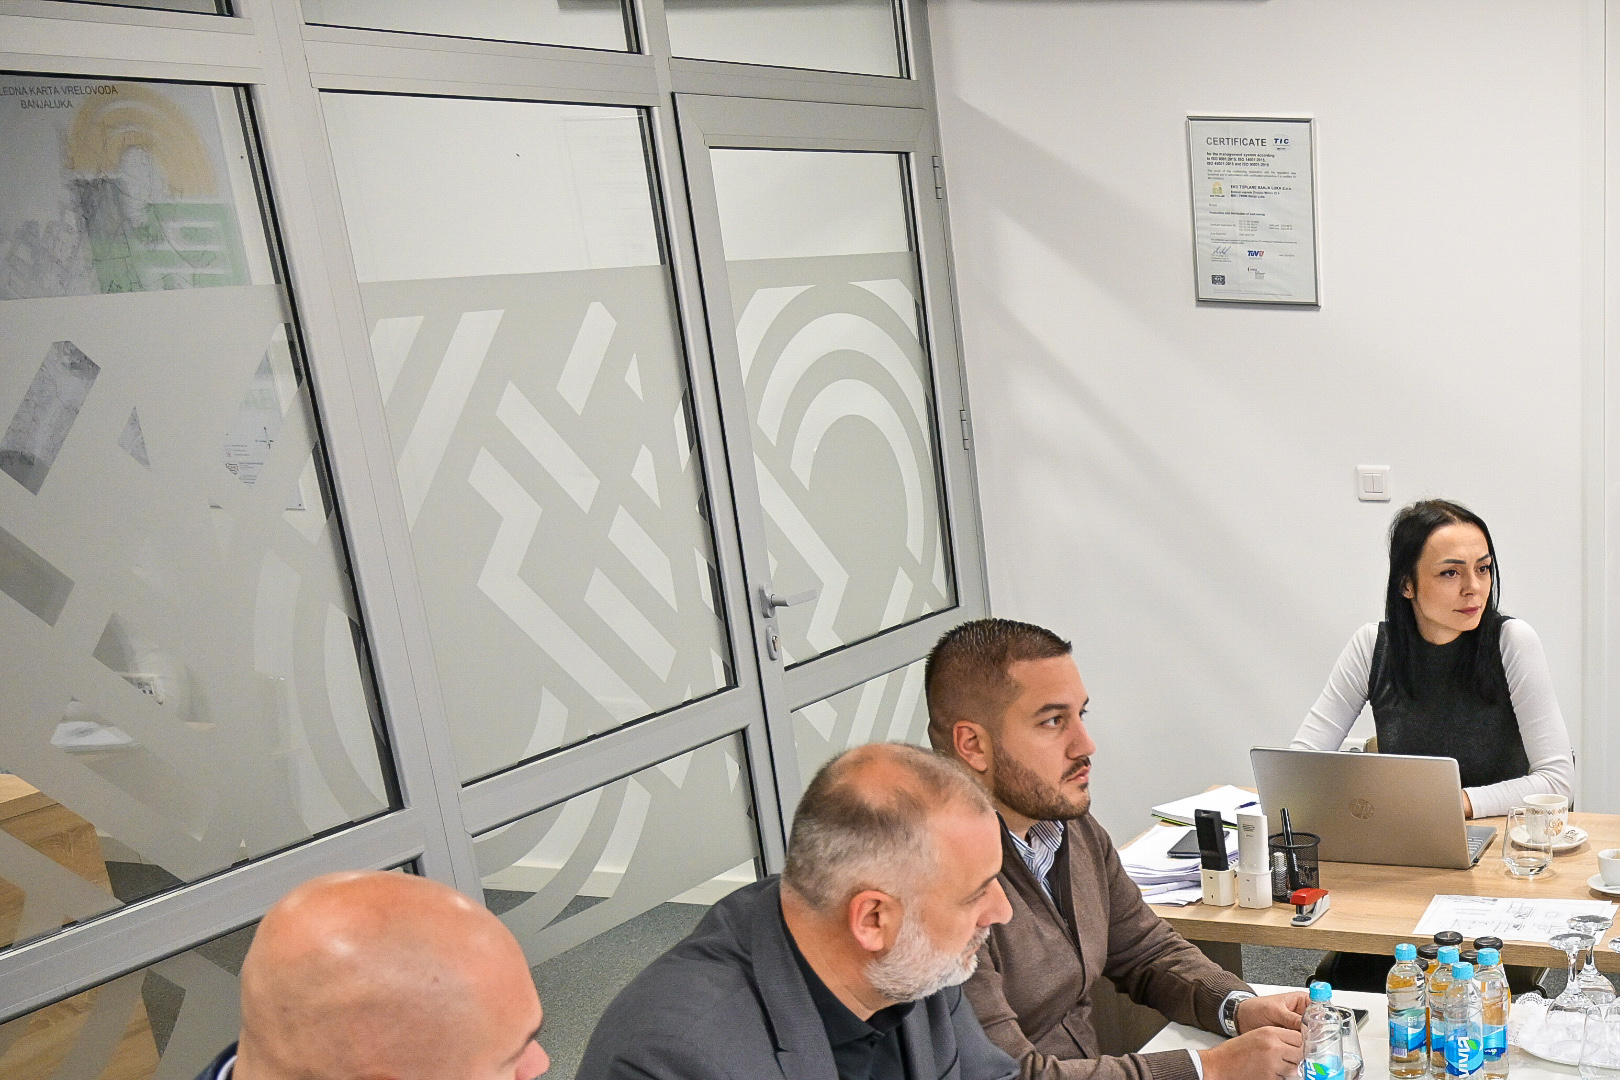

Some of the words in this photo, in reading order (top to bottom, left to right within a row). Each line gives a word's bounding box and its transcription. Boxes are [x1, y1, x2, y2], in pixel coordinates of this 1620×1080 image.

[0, 86, 28, 96] EDNA
[29, 86, 60, 95] KARTA
[60, 85, 118, 95] VRELOVODA
[21, 100, 74, 109] BANJALUKA
[1206, 136, 1267, 147] CERTIFICATE
[1273, 137, 1290, 145] TIC
